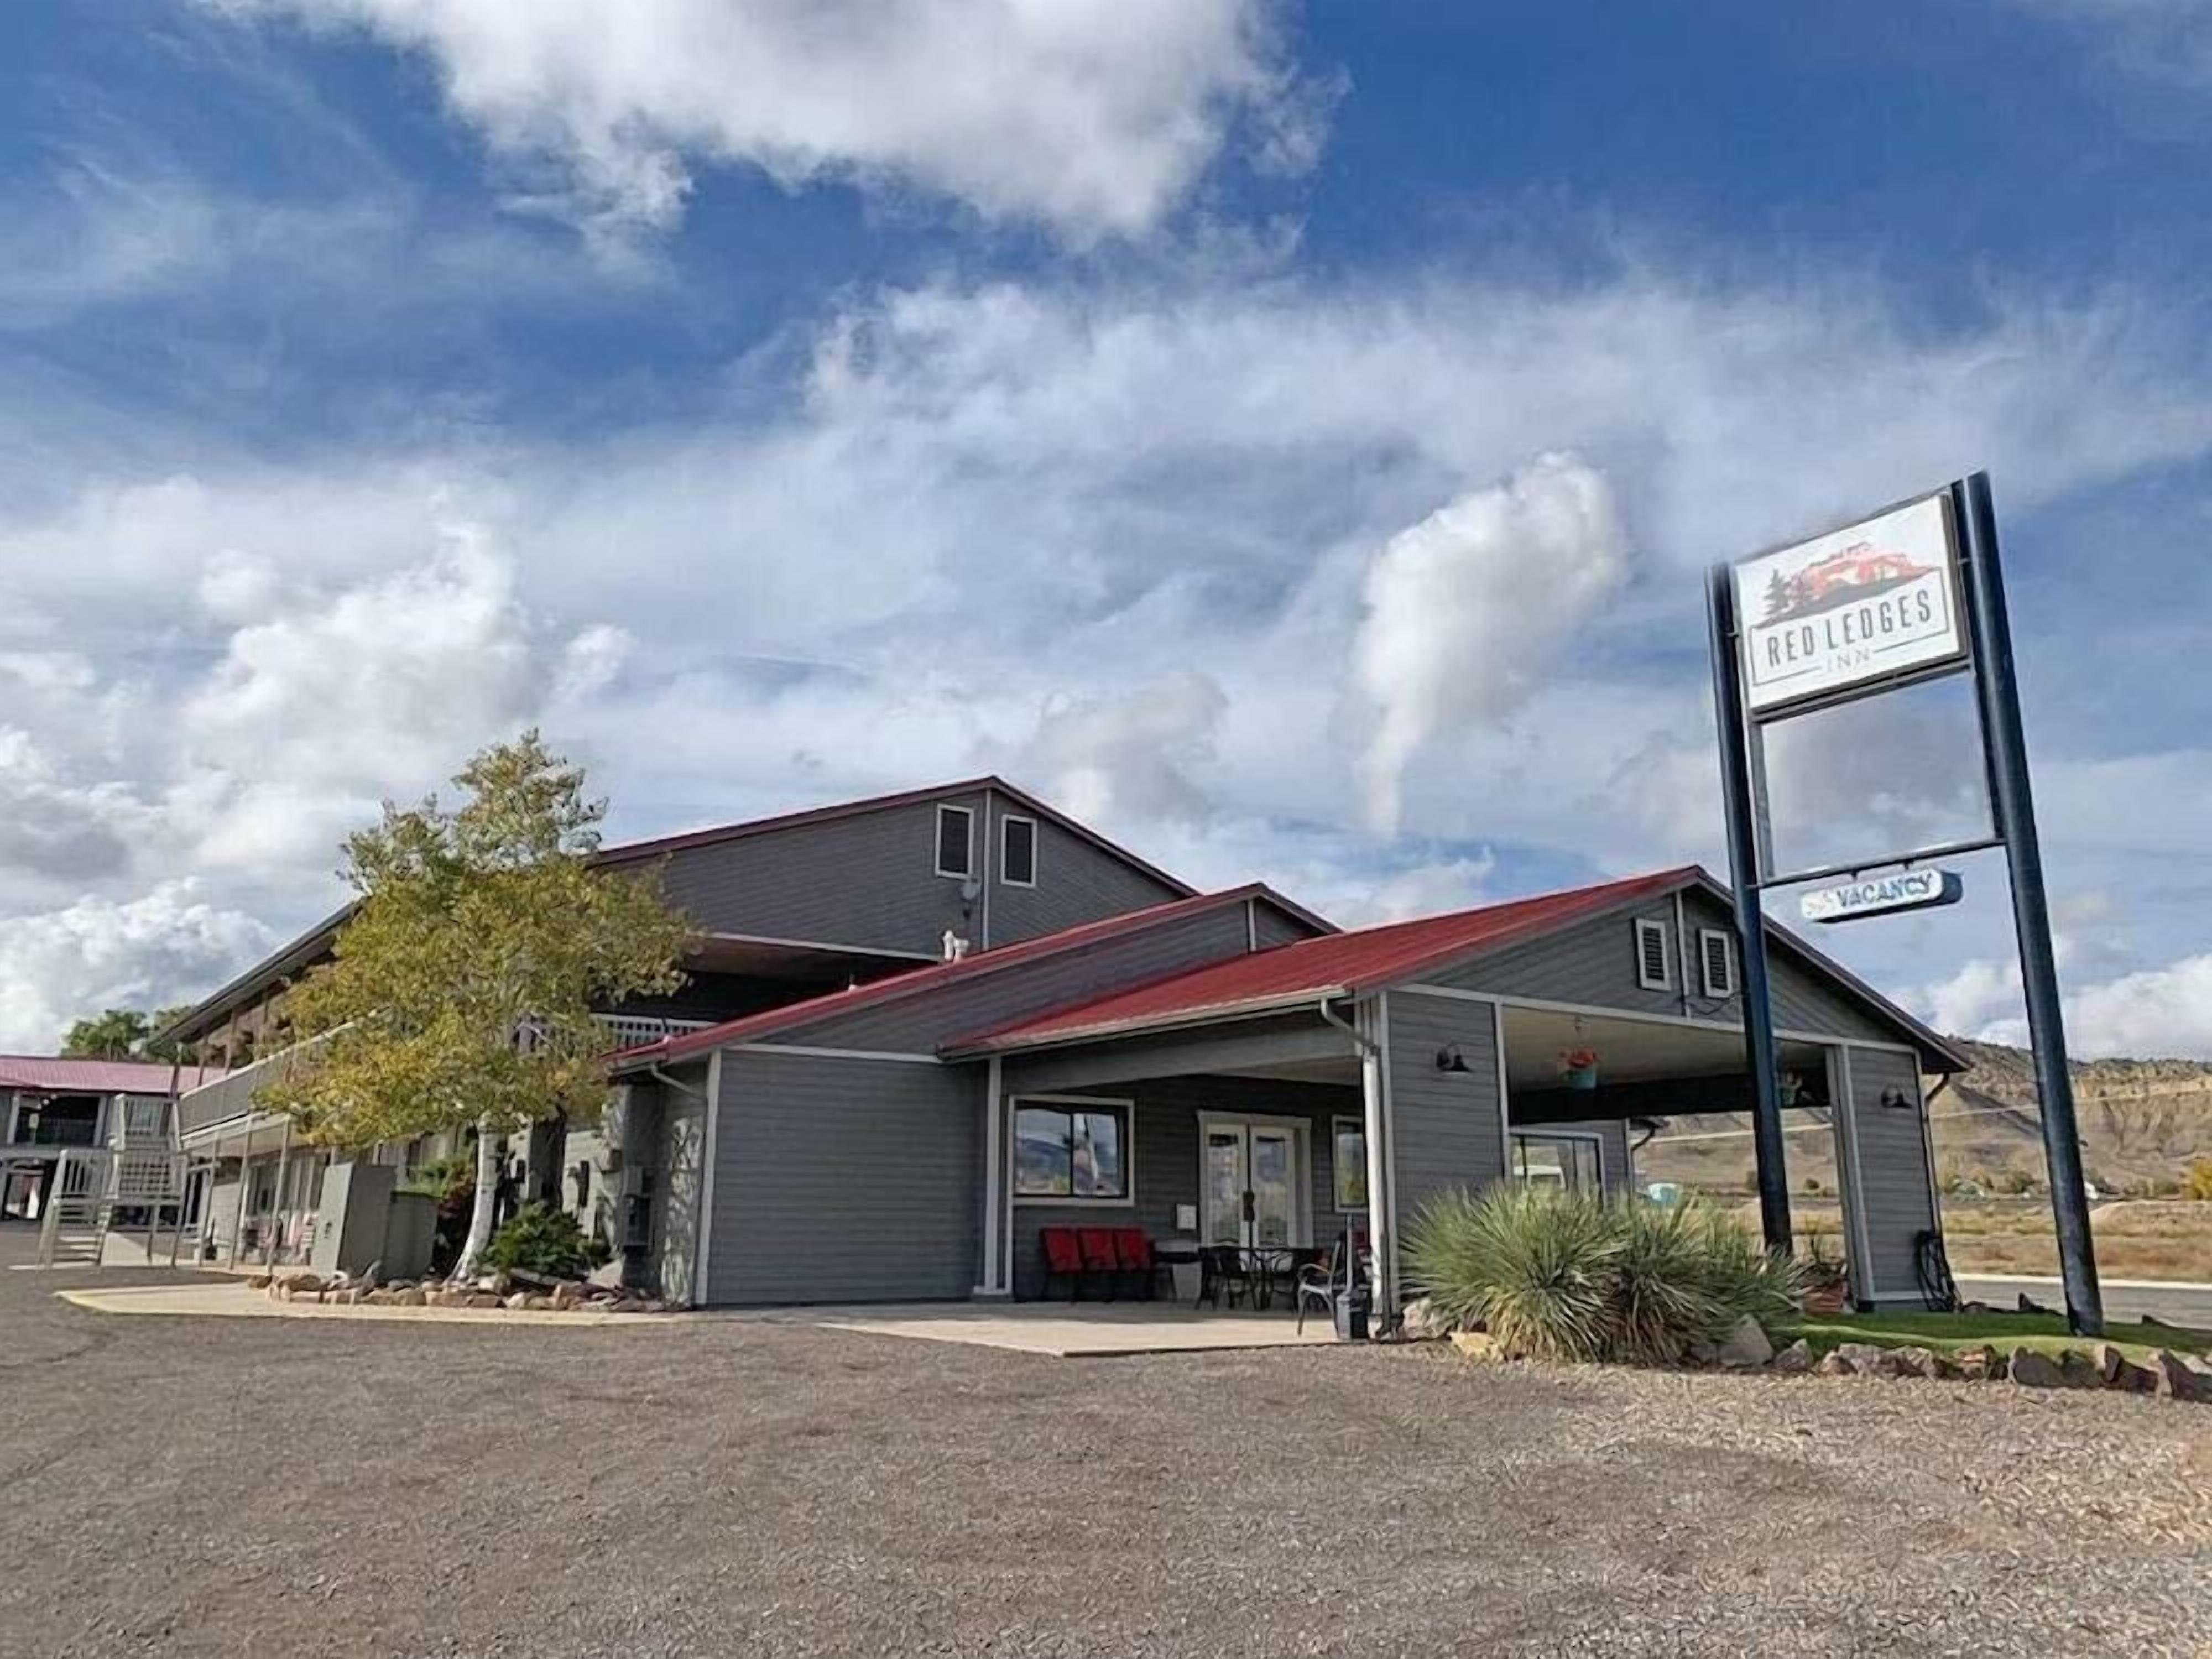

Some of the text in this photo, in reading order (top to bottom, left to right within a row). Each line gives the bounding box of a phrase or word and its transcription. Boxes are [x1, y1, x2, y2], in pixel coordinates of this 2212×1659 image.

[1767, 589, 1931, 667] RED LEDGES
[1826, 650, 1870, 672] INN
[1837, 873, 1932, 907] VACANCY
